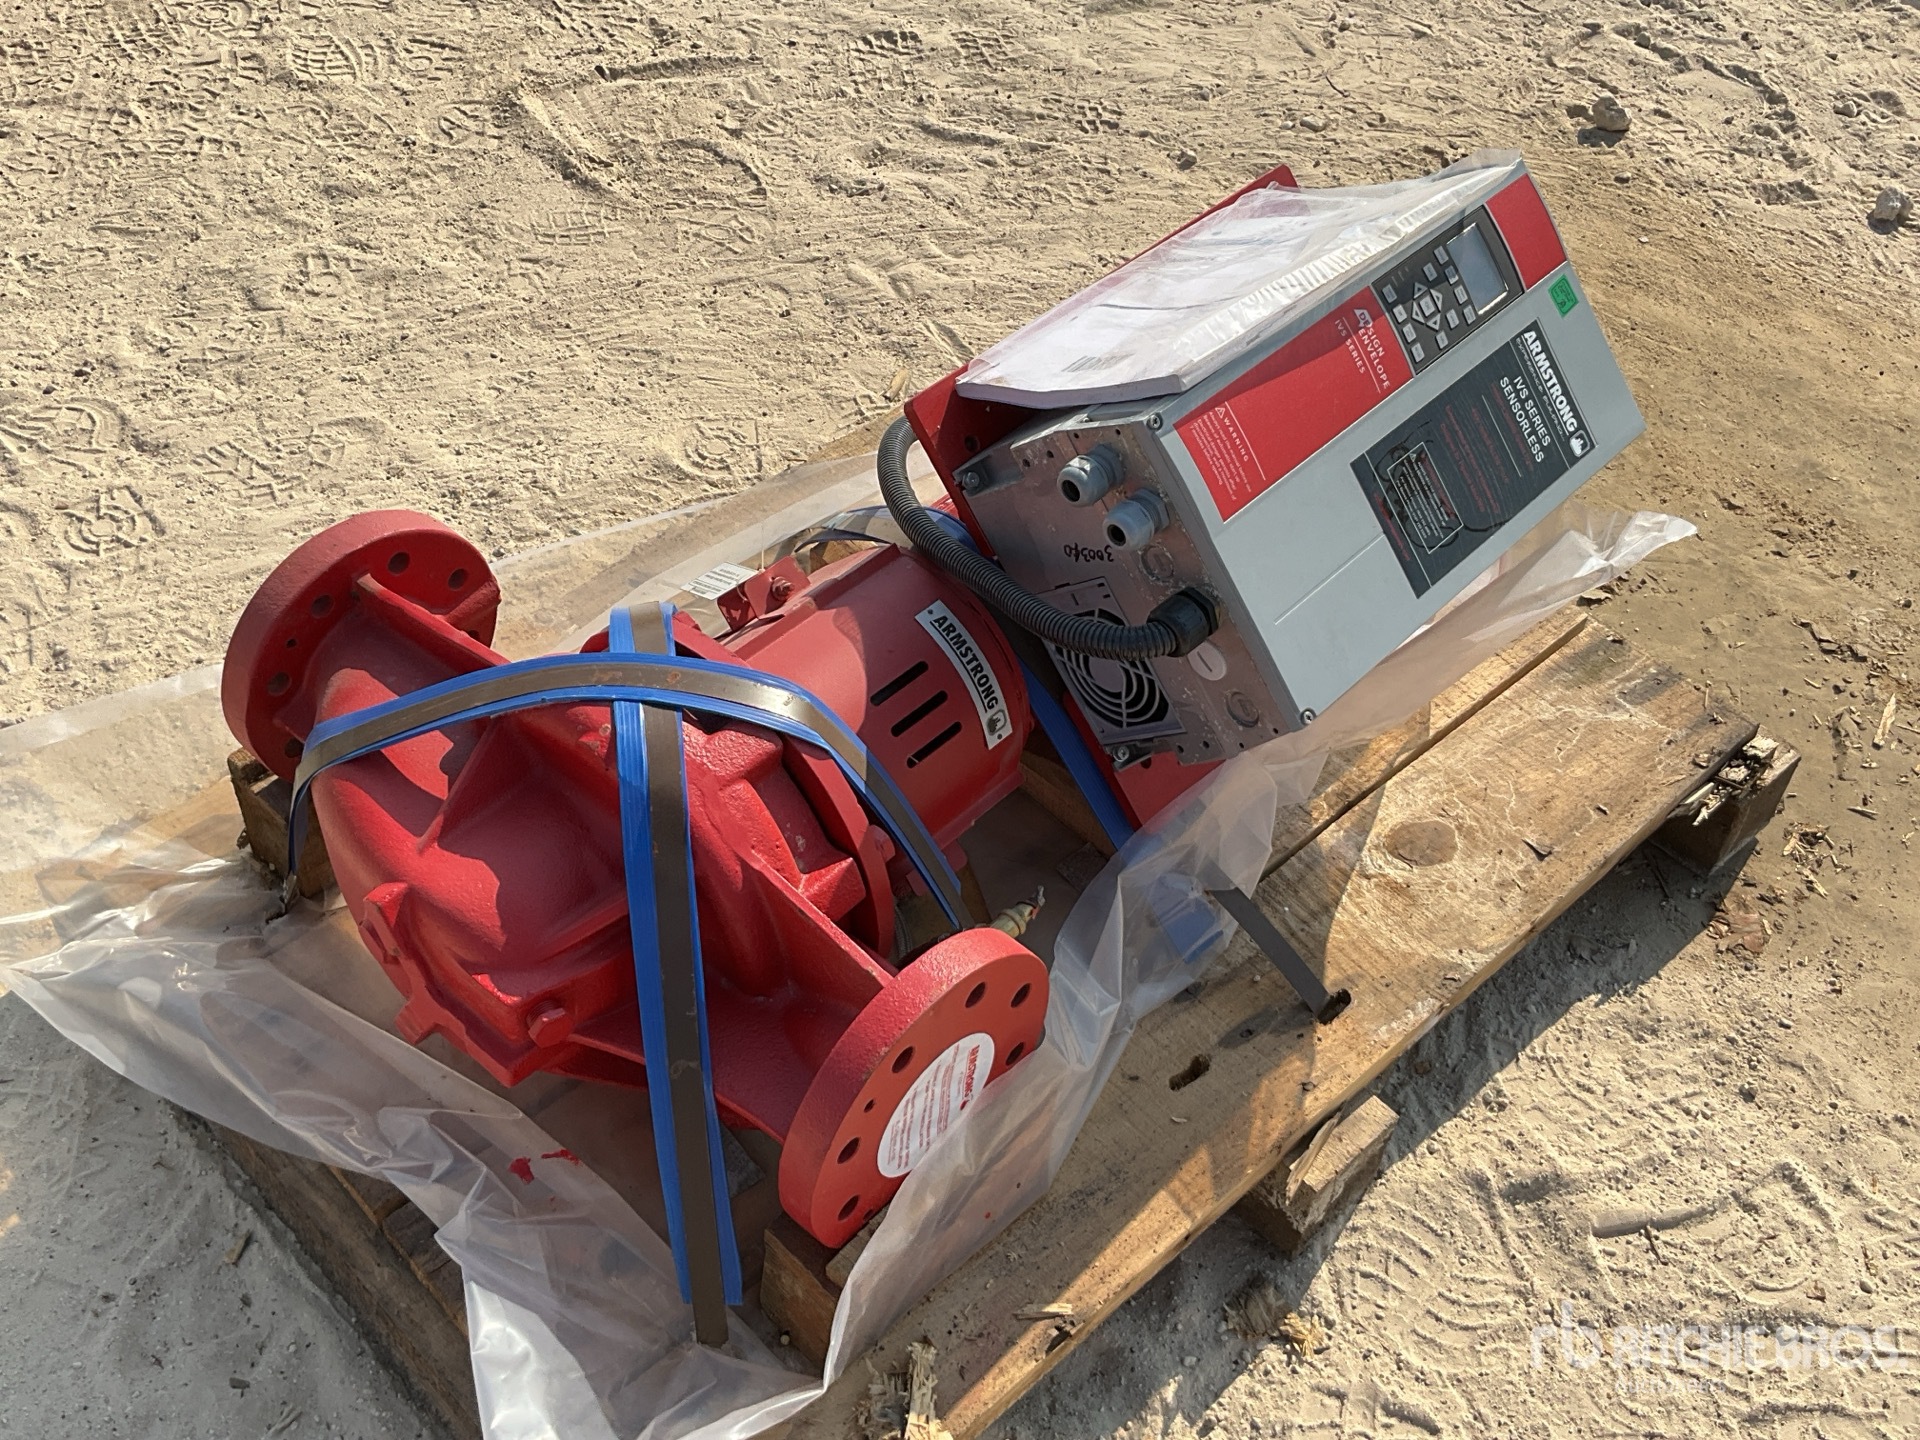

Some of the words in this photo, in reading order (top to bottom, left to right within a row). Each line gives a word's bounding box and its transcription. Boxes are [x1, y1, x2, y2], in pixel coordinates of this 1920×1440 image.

[1334, 319, 1347, 337] IVS
[1345, 338, 1366, 374] SERIES
[1357, 328, 1390, 389] ENVELOPE
[1512, 376, 1529, 399] IVS
[1523, 399, 1551, 446] SERIES
[1523, 330, 1579, 432] ARMSTRONG
[1196, 418, 1212, 441] Electrical
[1209, 441, 1221, 458] danger
[1208, 411, 1220, 429] Always
[1229, 449, 1240, 467] manual
[1238, 466, 1247, 483] before
[1224, 418, 1249, 461] WARNING
[1498, 376, 1545, 463] SENSORLESS
[1216, 438, 1230, 463] automatic
[1228, 462, 1237, 476] start
[935, 615, 998, 710] ARMSTRONG
